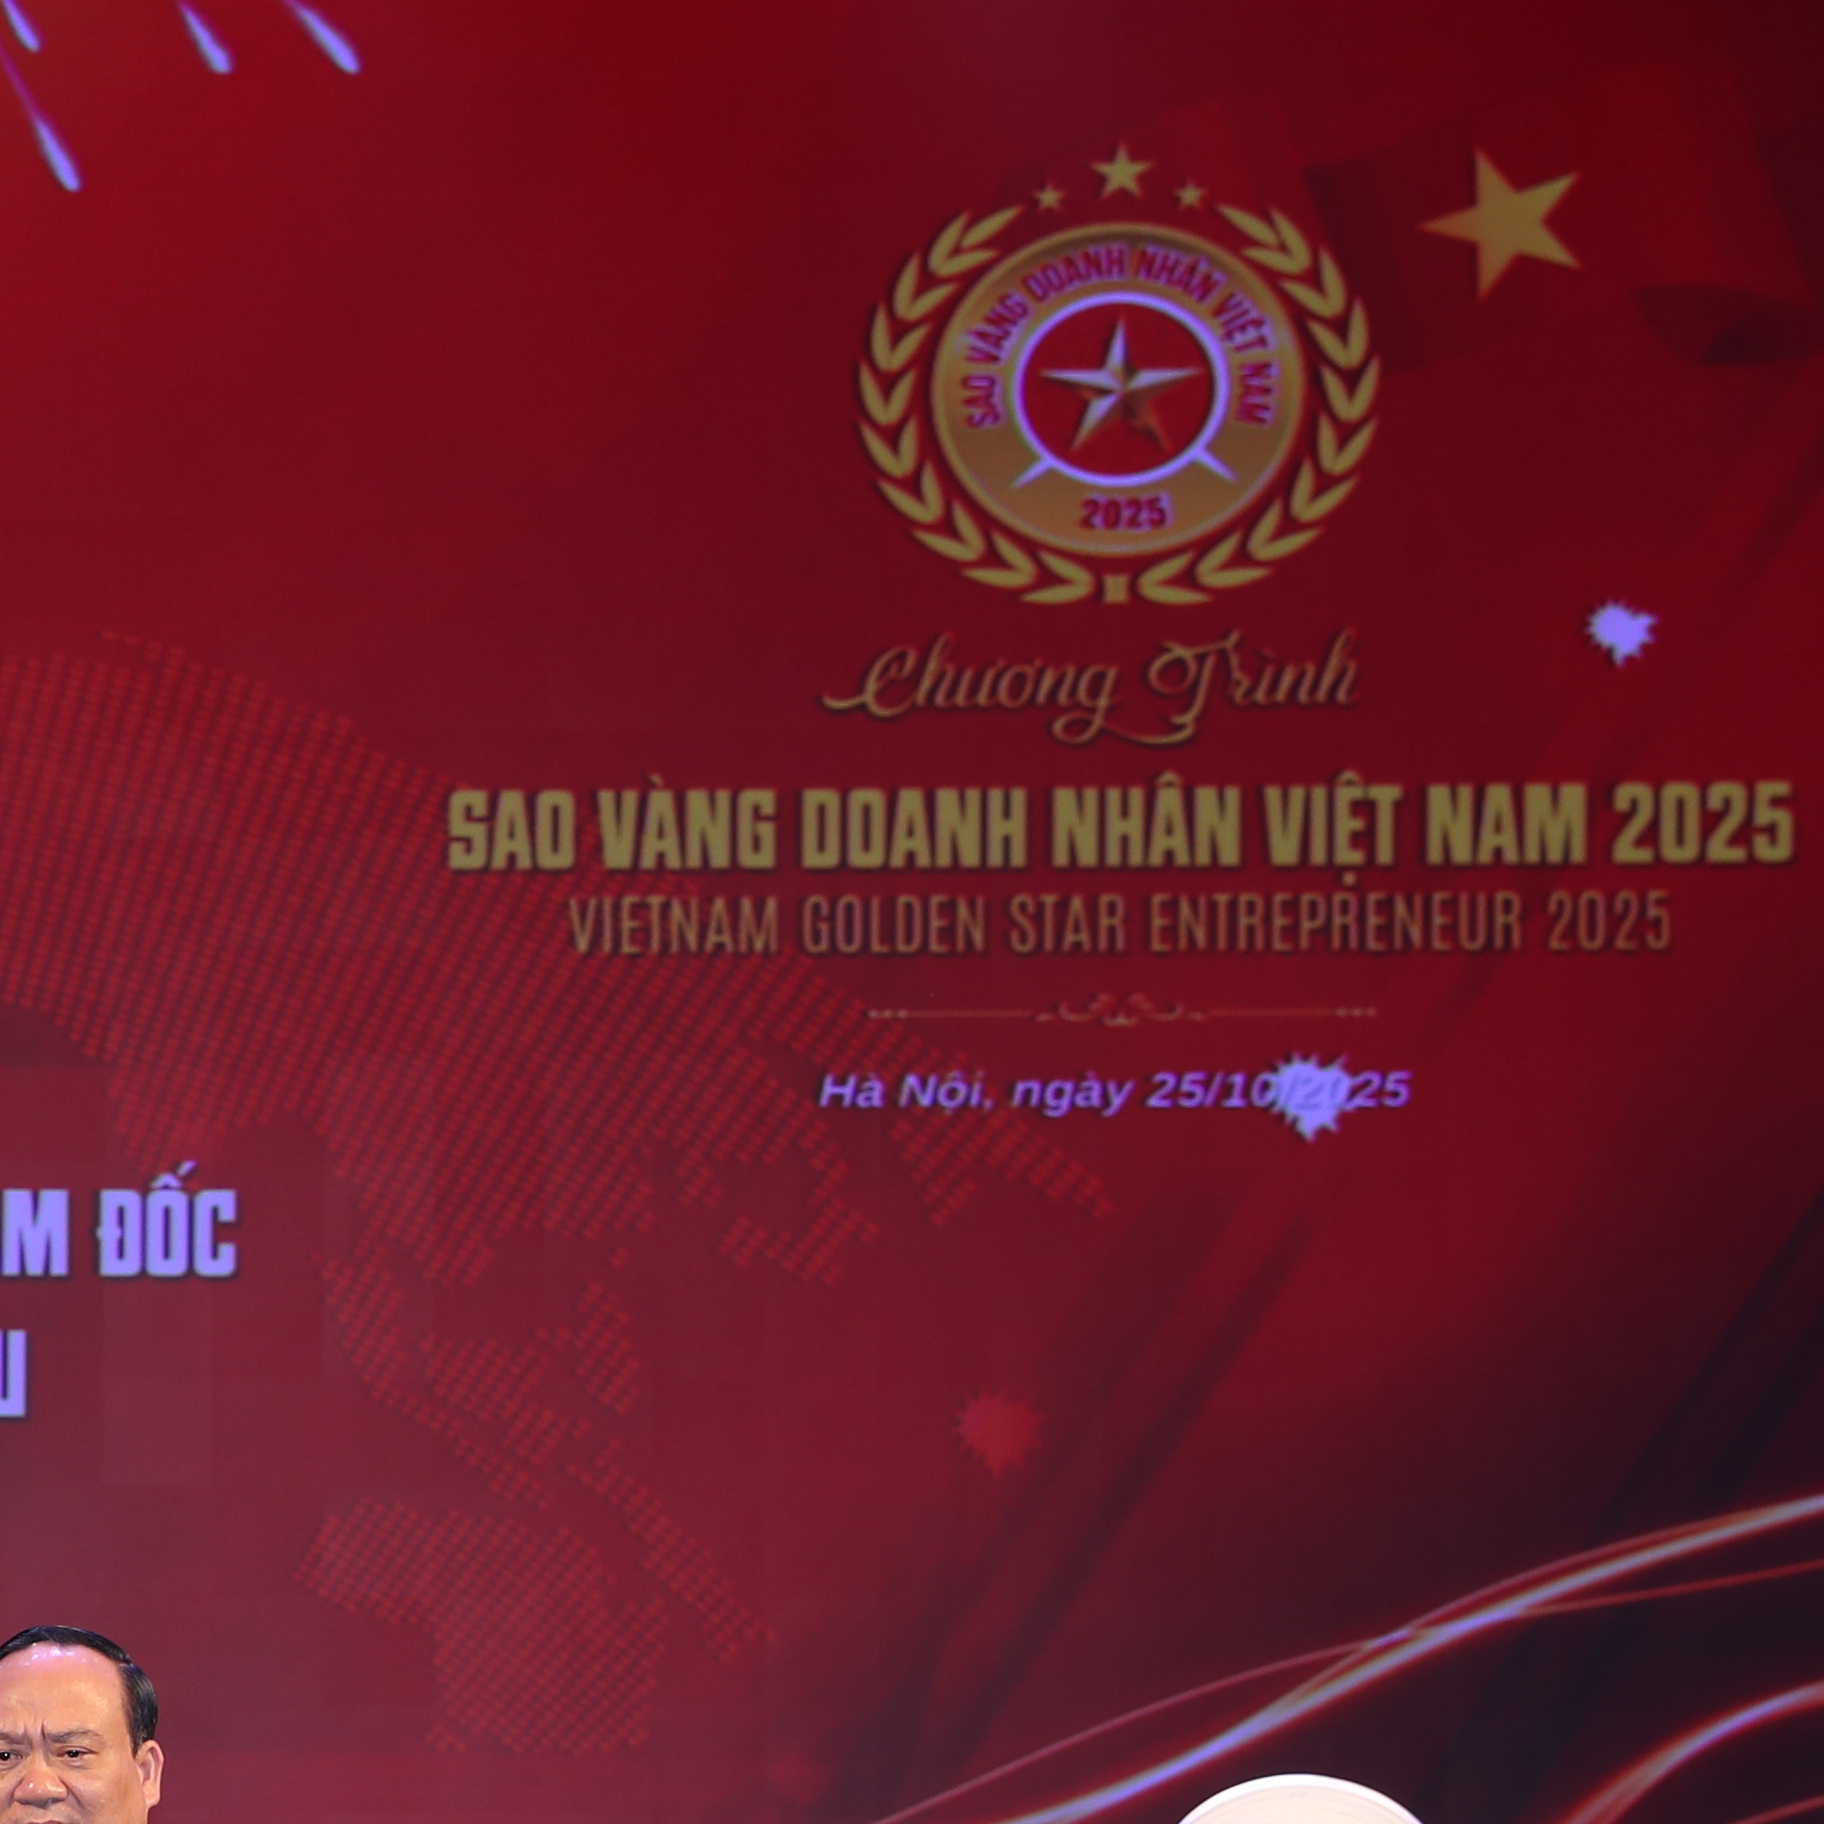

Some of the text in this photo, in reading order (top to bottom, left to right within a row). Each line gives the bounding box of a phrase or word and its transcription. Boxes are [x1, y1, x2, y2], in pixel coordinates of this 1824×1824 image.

[1022, 242, 1130, 303] DOANH
[1235, 359, 1282, 428] NAM
[1078, 492, 1174, 532] 2025
[820, 629, 1358, 746] Chương Trình
[448, 770, 1793, 886] SAO VÀNG DOANH NHÂN VIỆT NAM 2025
[568, 890, 1672, 955] VIETNAM GOLDEN STAR ENTREPRENEUR 2025
[818, 1072, 885, 1109] Hà
[898, 1070, 993, 1116] Nội,
[1012, 1071, 1133, 1117] ngày
[97, 1160, 237, 1278] ĐỐC
